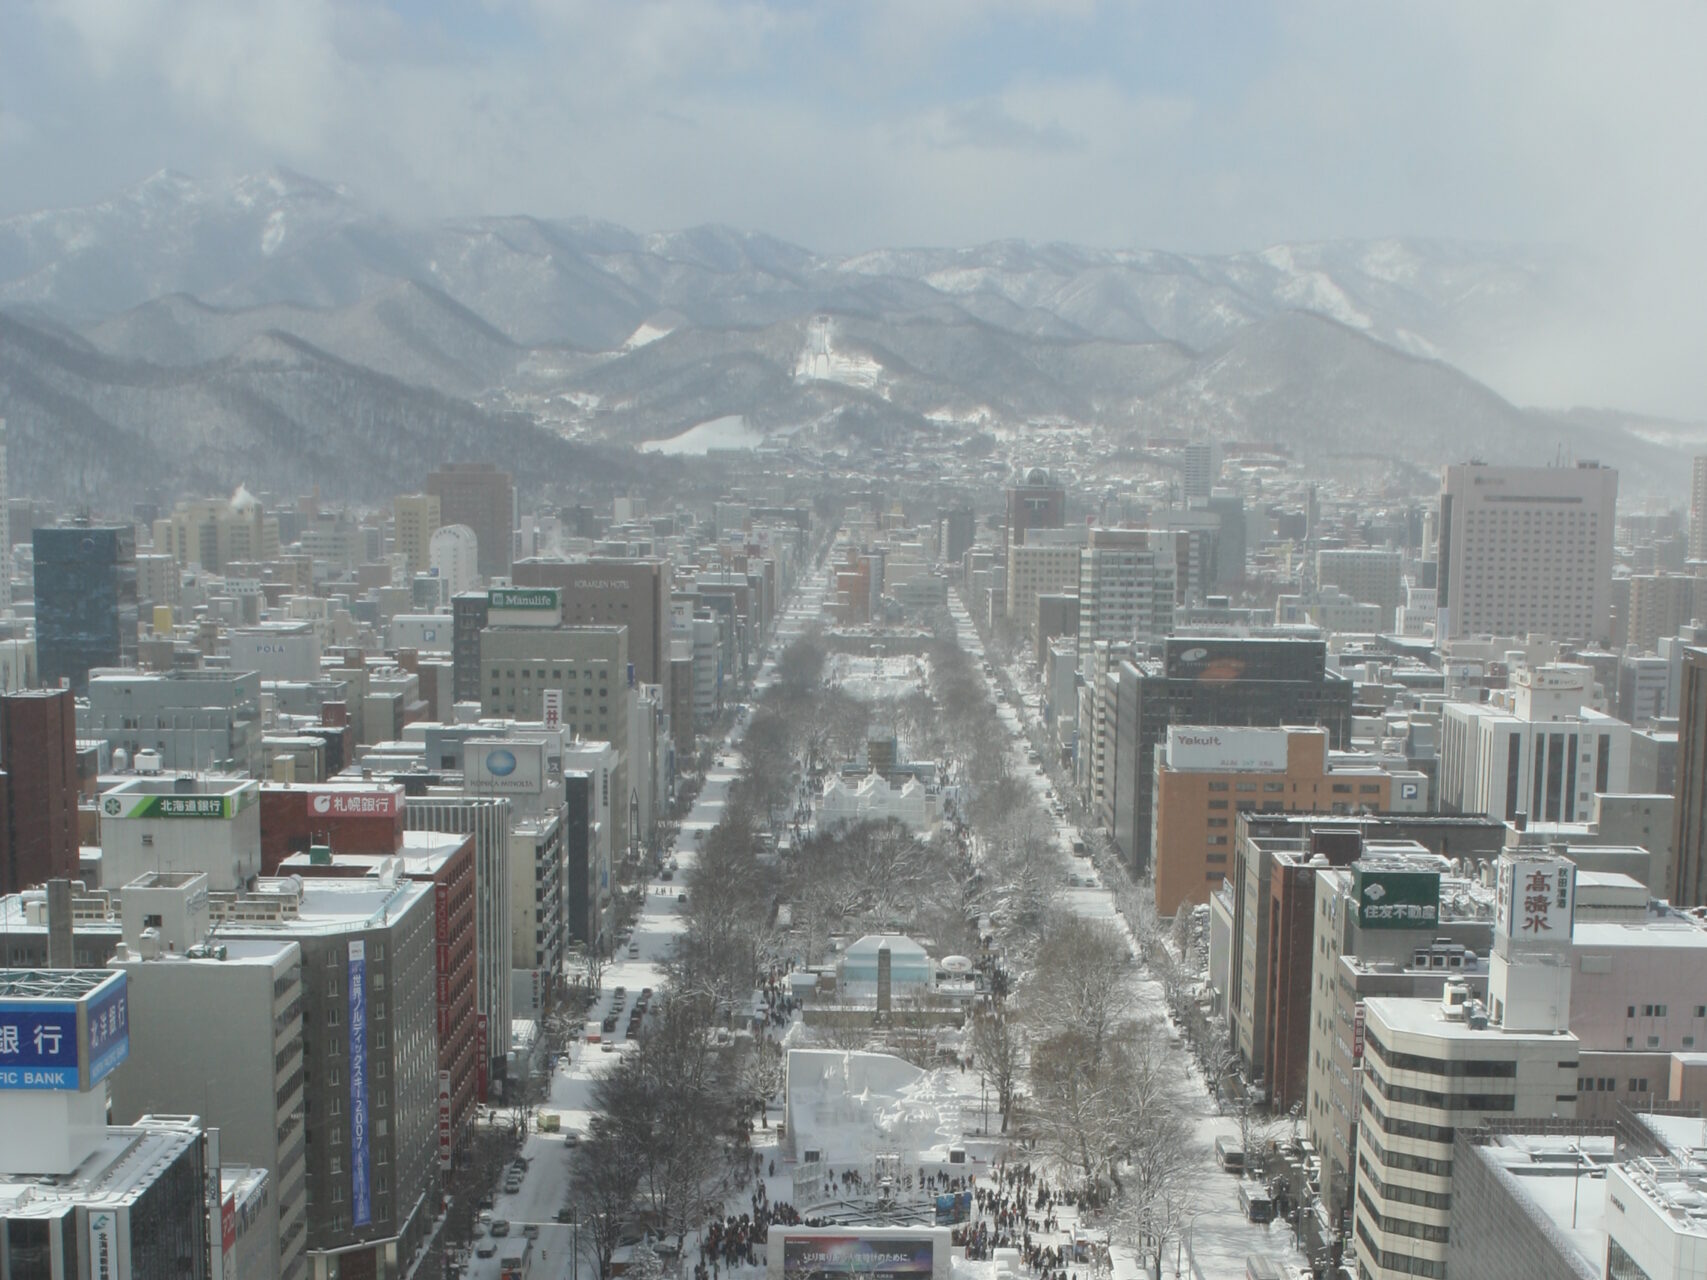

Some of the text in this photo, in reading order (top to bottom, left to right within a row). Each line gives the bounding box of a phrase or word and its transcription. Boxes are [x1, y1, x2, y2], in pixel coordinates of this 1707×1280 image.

[505, 593, 551, 606] Manulife
[425, 632, 434, 641] P
[257, 645, 284, 653] POLA
[1178, 736, 1221, 746] Yakult
[470, 780, 533, 788] KONICA MINOLTA
[1403, 785, 1417, 798] P
[161, 800, 221, 812] 北海道銀行
[334, 797, 389, 812] 札幌銀行
[1364, 904, 1436, 919] 住友不動産
[0, 1024, 62, 1055] 銀行
[24, 1073, 64, 1084] BANK
